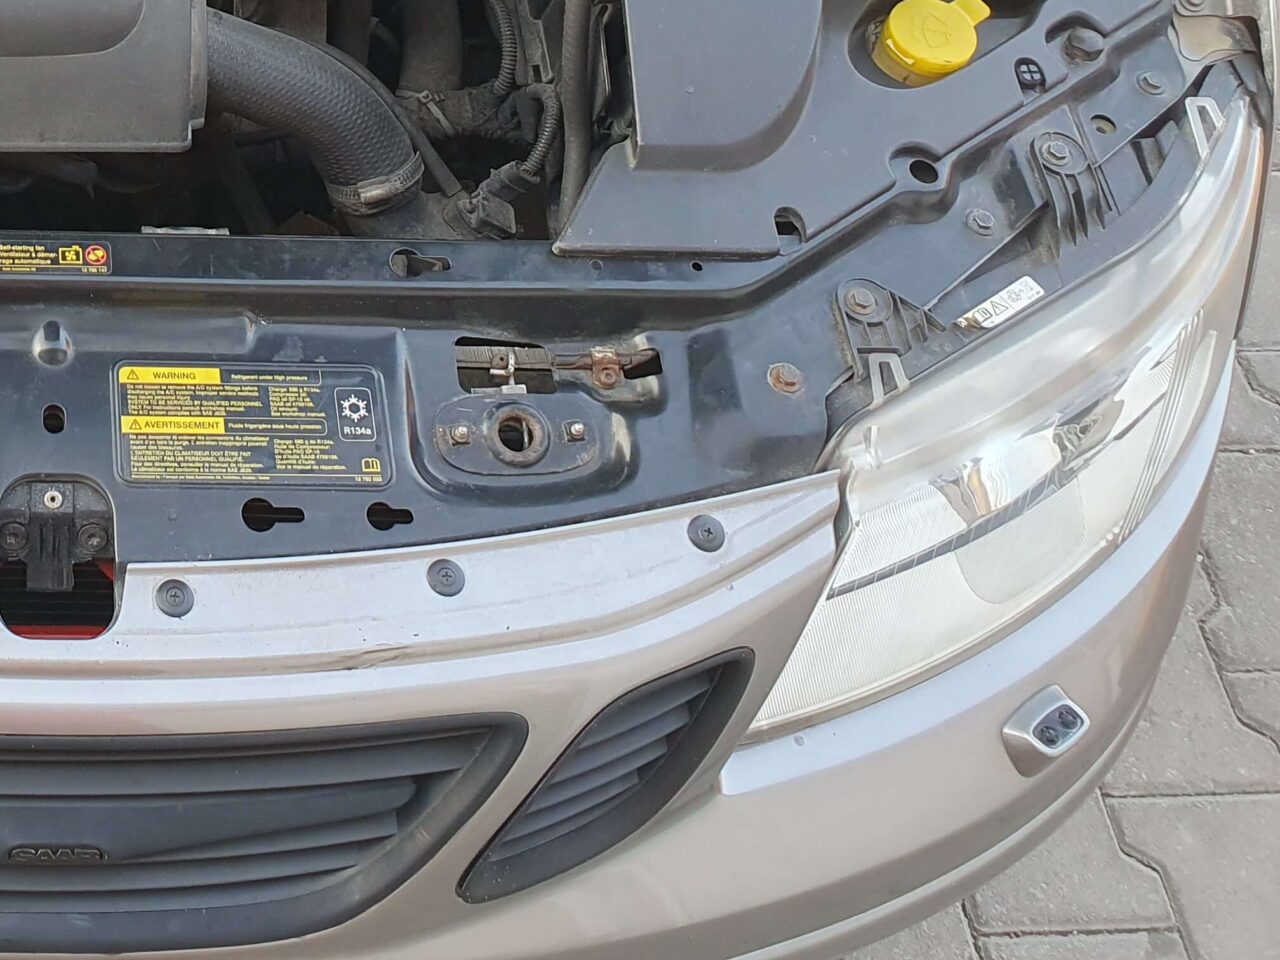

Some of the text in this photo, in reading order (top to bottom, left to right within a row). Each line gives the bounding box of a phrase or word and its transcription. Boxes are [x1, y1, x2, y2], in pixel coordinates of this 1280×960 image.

[153, 372, 196, 380] WARNING
[144, 420, 220, 429] AVERTISSEMENT
[344, 427, 372, 435] R134a
[11, 848, 103, 861] SAAB
